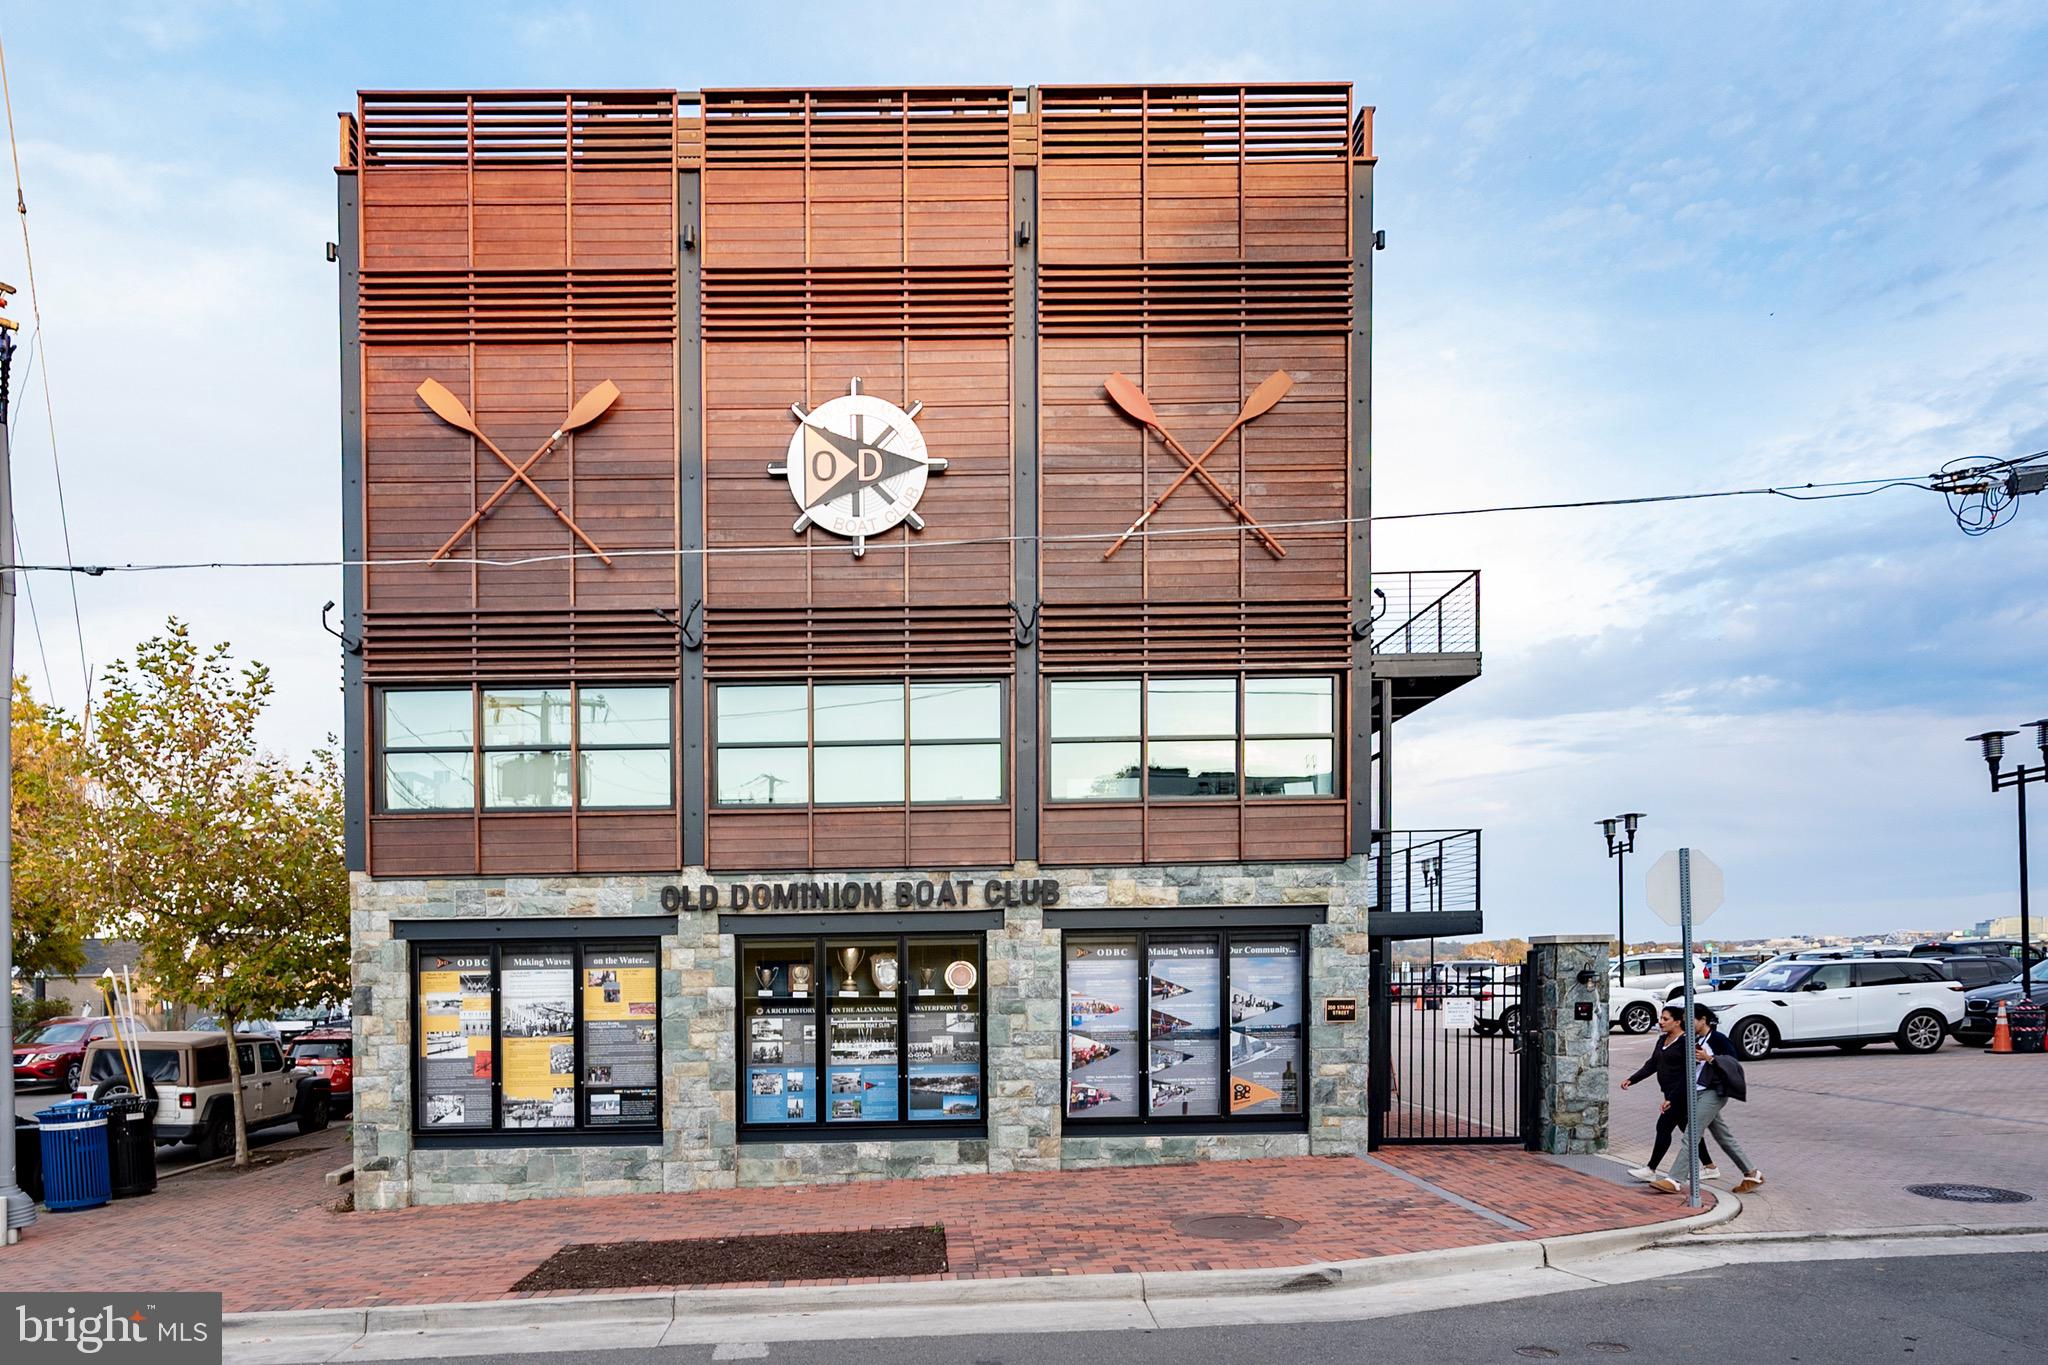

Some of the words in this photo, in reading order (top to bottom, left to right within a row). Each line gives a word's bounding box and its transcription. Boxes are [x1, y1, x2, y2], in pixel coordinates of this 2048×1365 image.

[833, 516, 877, 533] BOAT
[884, 486, 920, 525] CLUB
[660, 884, 719, 913] OLD
[730, 880, 882, 911] DOMINION
[895, 880, 974, 908] BOAT
[984, 878, 1061, 906] CLUB
[1097, 948, 1128, 957] ODBC
[1148, 947, 1178, 957] Making
[1180, 947, 1205, 956] Waves
[1206, 947, 1214, 955] in
[457, 957, 489, 968] ODBC
[513, 957, 544, 968] Making
[546, 957, 571, 967] Waves
[593, 957, 604, 966] on
[605, 956, 617, 965] the
